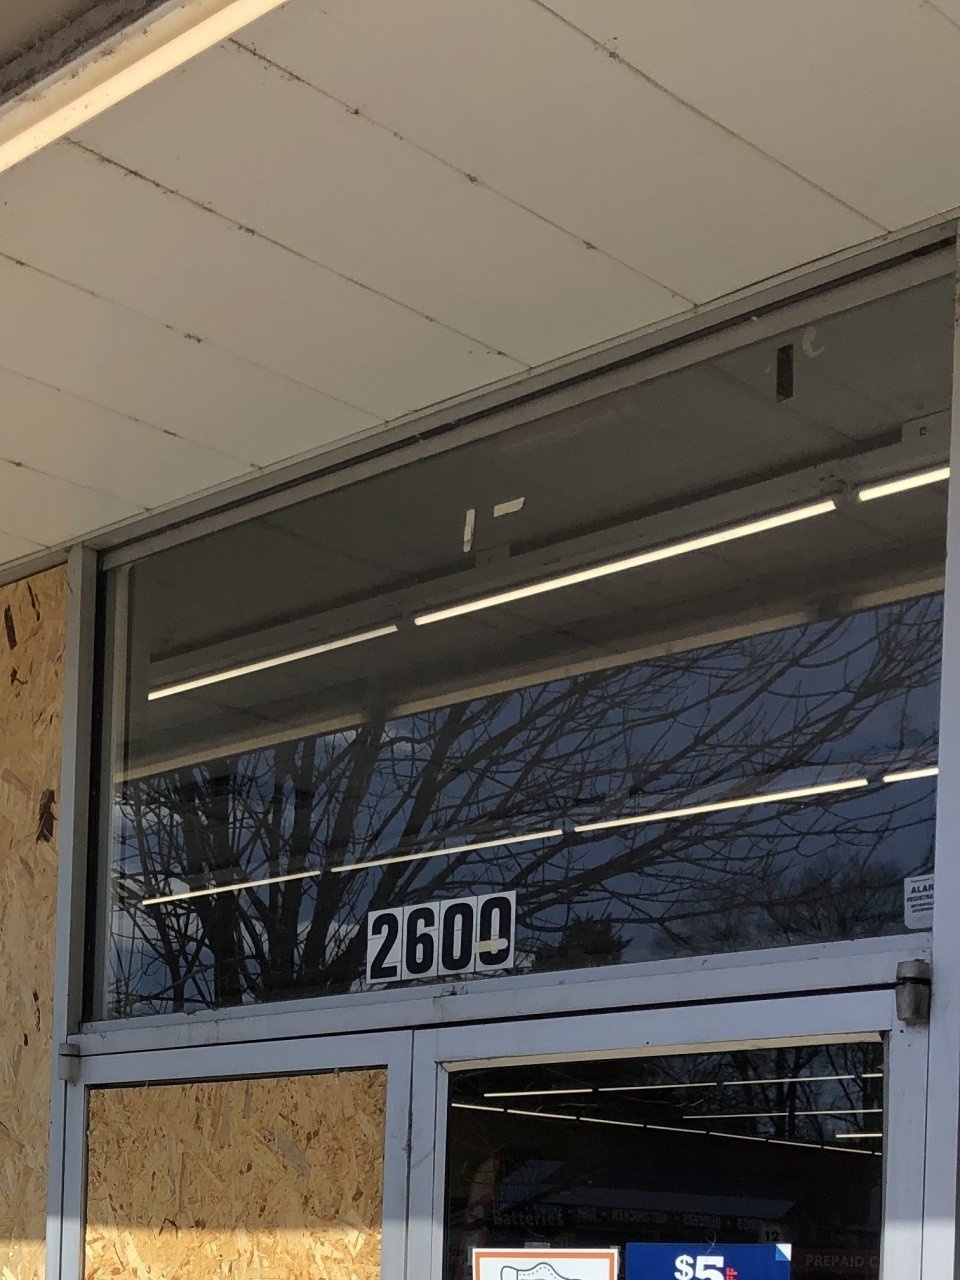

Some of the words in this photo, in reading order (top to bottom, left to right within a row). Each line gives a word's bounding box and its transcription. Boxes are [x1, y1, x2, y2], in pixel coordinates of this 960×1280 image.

[911, 883, 934, 895] ALAR
[370, 896, 512, 980] 2600
[805, 1254, 864, 1268] PREPAID
